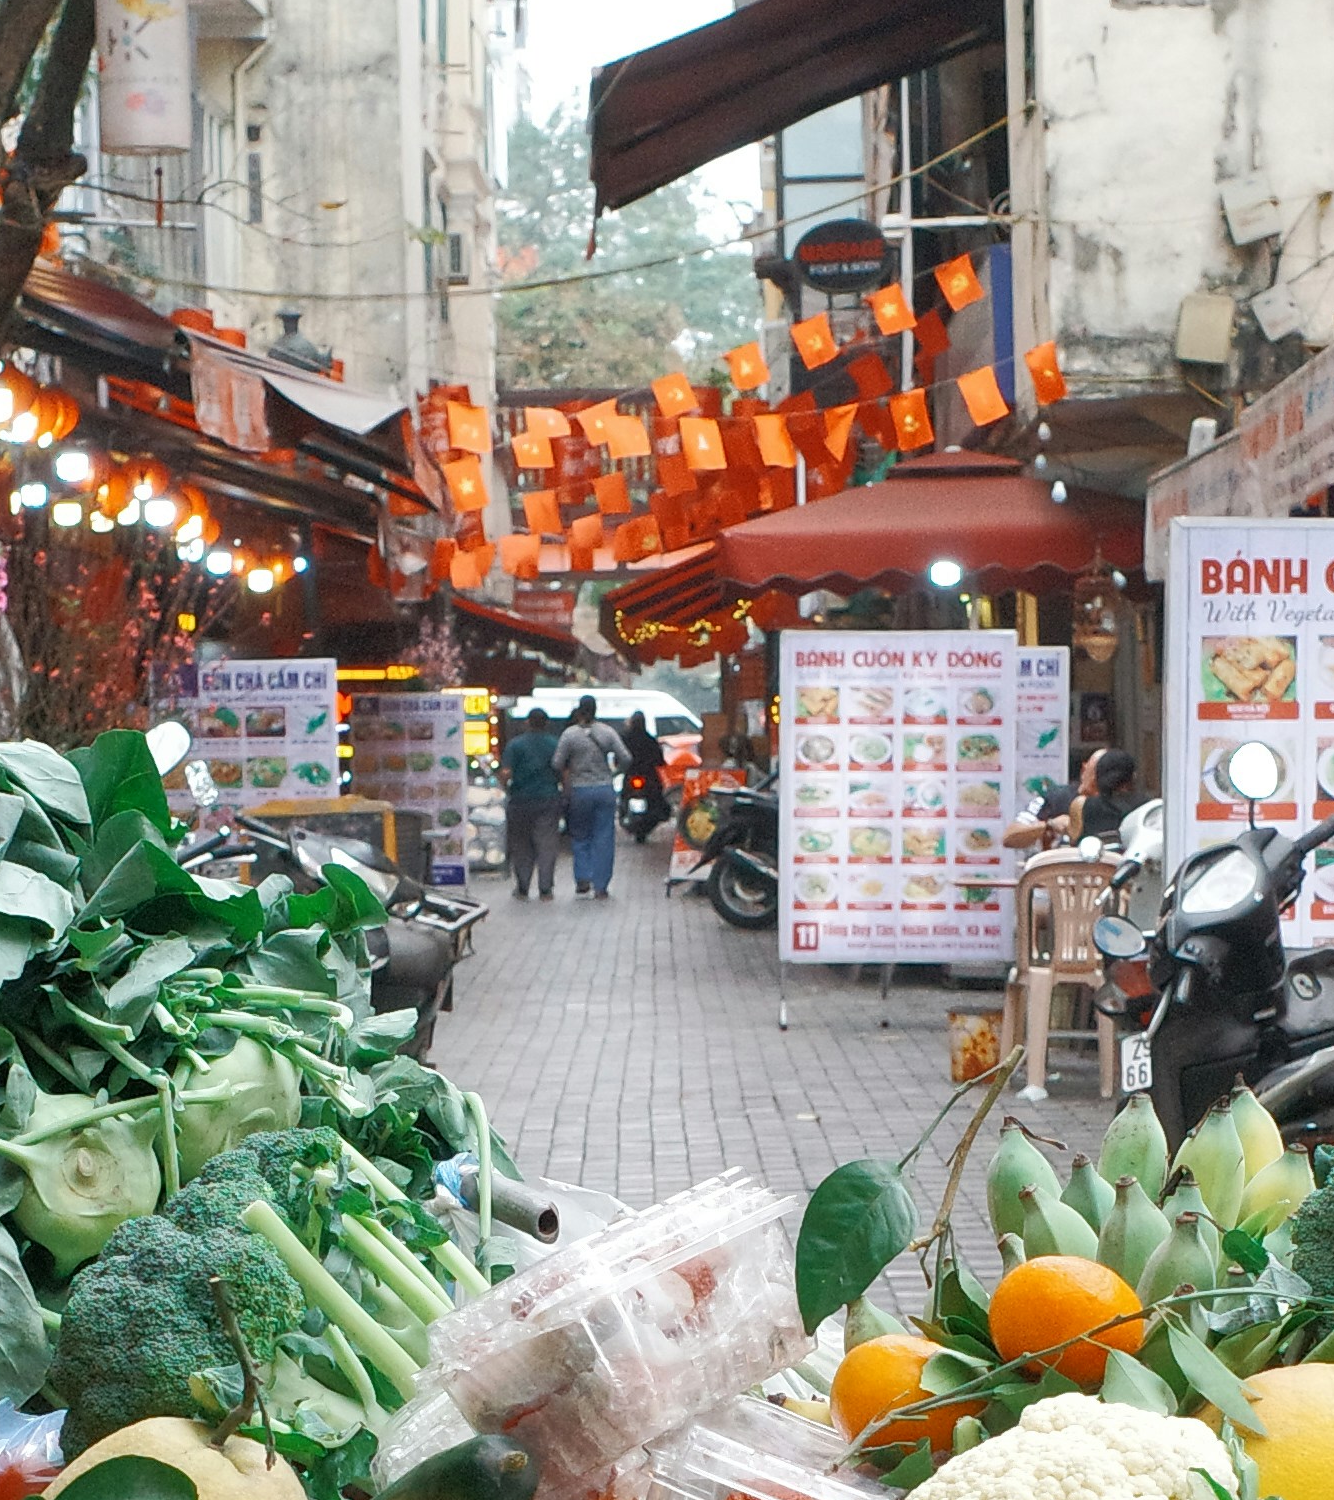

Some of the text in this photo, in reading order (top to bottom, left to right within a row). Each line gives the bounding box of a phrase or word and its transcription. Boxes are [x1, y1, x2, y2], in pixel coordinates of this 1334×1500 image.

[1201, 549, 1308, 595] BÁNH
[1203, 599, 1258, 624] With
[1126, 1062, 1148, 1087] 66
